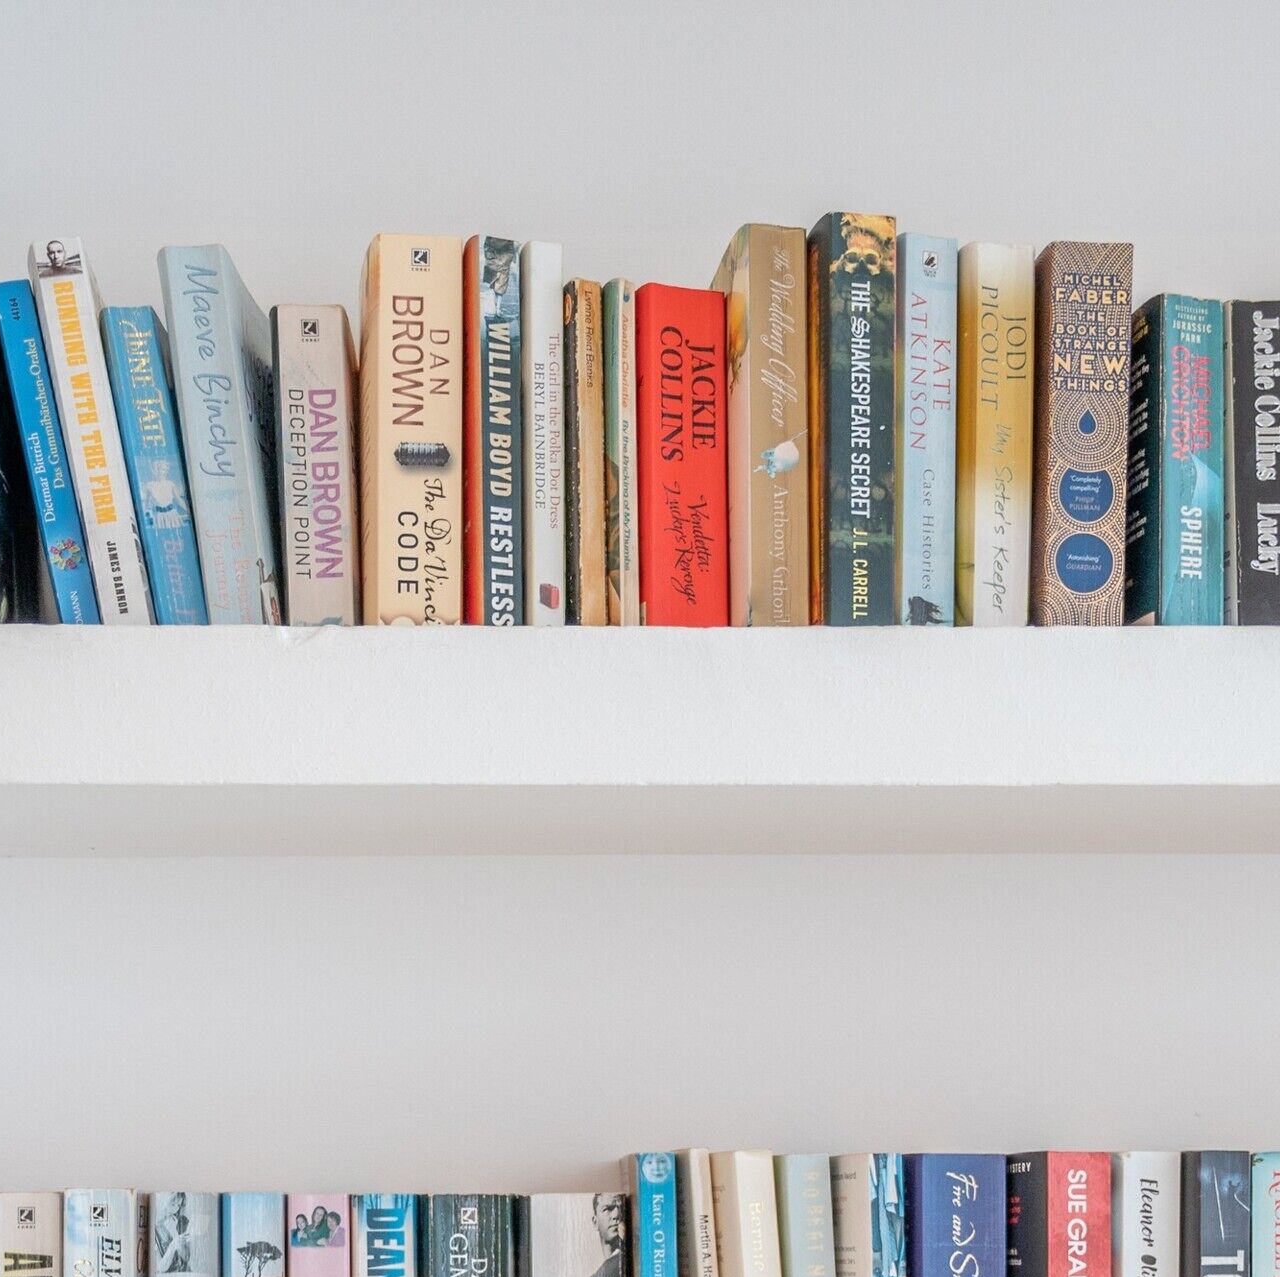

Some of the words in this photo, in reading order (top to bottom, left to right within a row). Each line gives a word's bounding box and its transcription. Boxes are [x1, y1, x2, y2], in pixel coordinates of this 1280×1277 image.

[53, 281, 87, 366] RUNNING
[851, 281, 870, 311] THE
[392, 296, 424, 425] BROWN
[430, 329, 450, 395] DAN
[489, 323, 511, 424] WILLIAM
[850, 317, 870, 447] SHAKESPEARE
[910, 293, 928, 449] ATKINSON
[933, 338, 951, 411] KATE
[1252, 312, 1280, 390] Jackie
[69, 373, 96, 425] WITH
[308, 389, 339, 452] DAN
[660, 326, 683, 461] COLLINS
[686, 340, 716, 449] JACKIE
[79, 430, 107, 469] THE
[289, 389, 308, 506] DECEPTION
[490, 428, 512, 496] BOYD
[90, 474, 117, 525] FIRM
[312, 462, 344, 579] BROWN
[851, 453, 870, 518] SECRET
[922, 469, 935, 505] Case
[106, 541, 121, 573] JAMES
[294, 517, 311, 579] POINT
[490, 506, 514, 626] RESTLESS
[922, 515, 936, 590] Histories
[112, 577, 129, 615] BANNON
[1068, 1169, 1087, 1212] SUE
